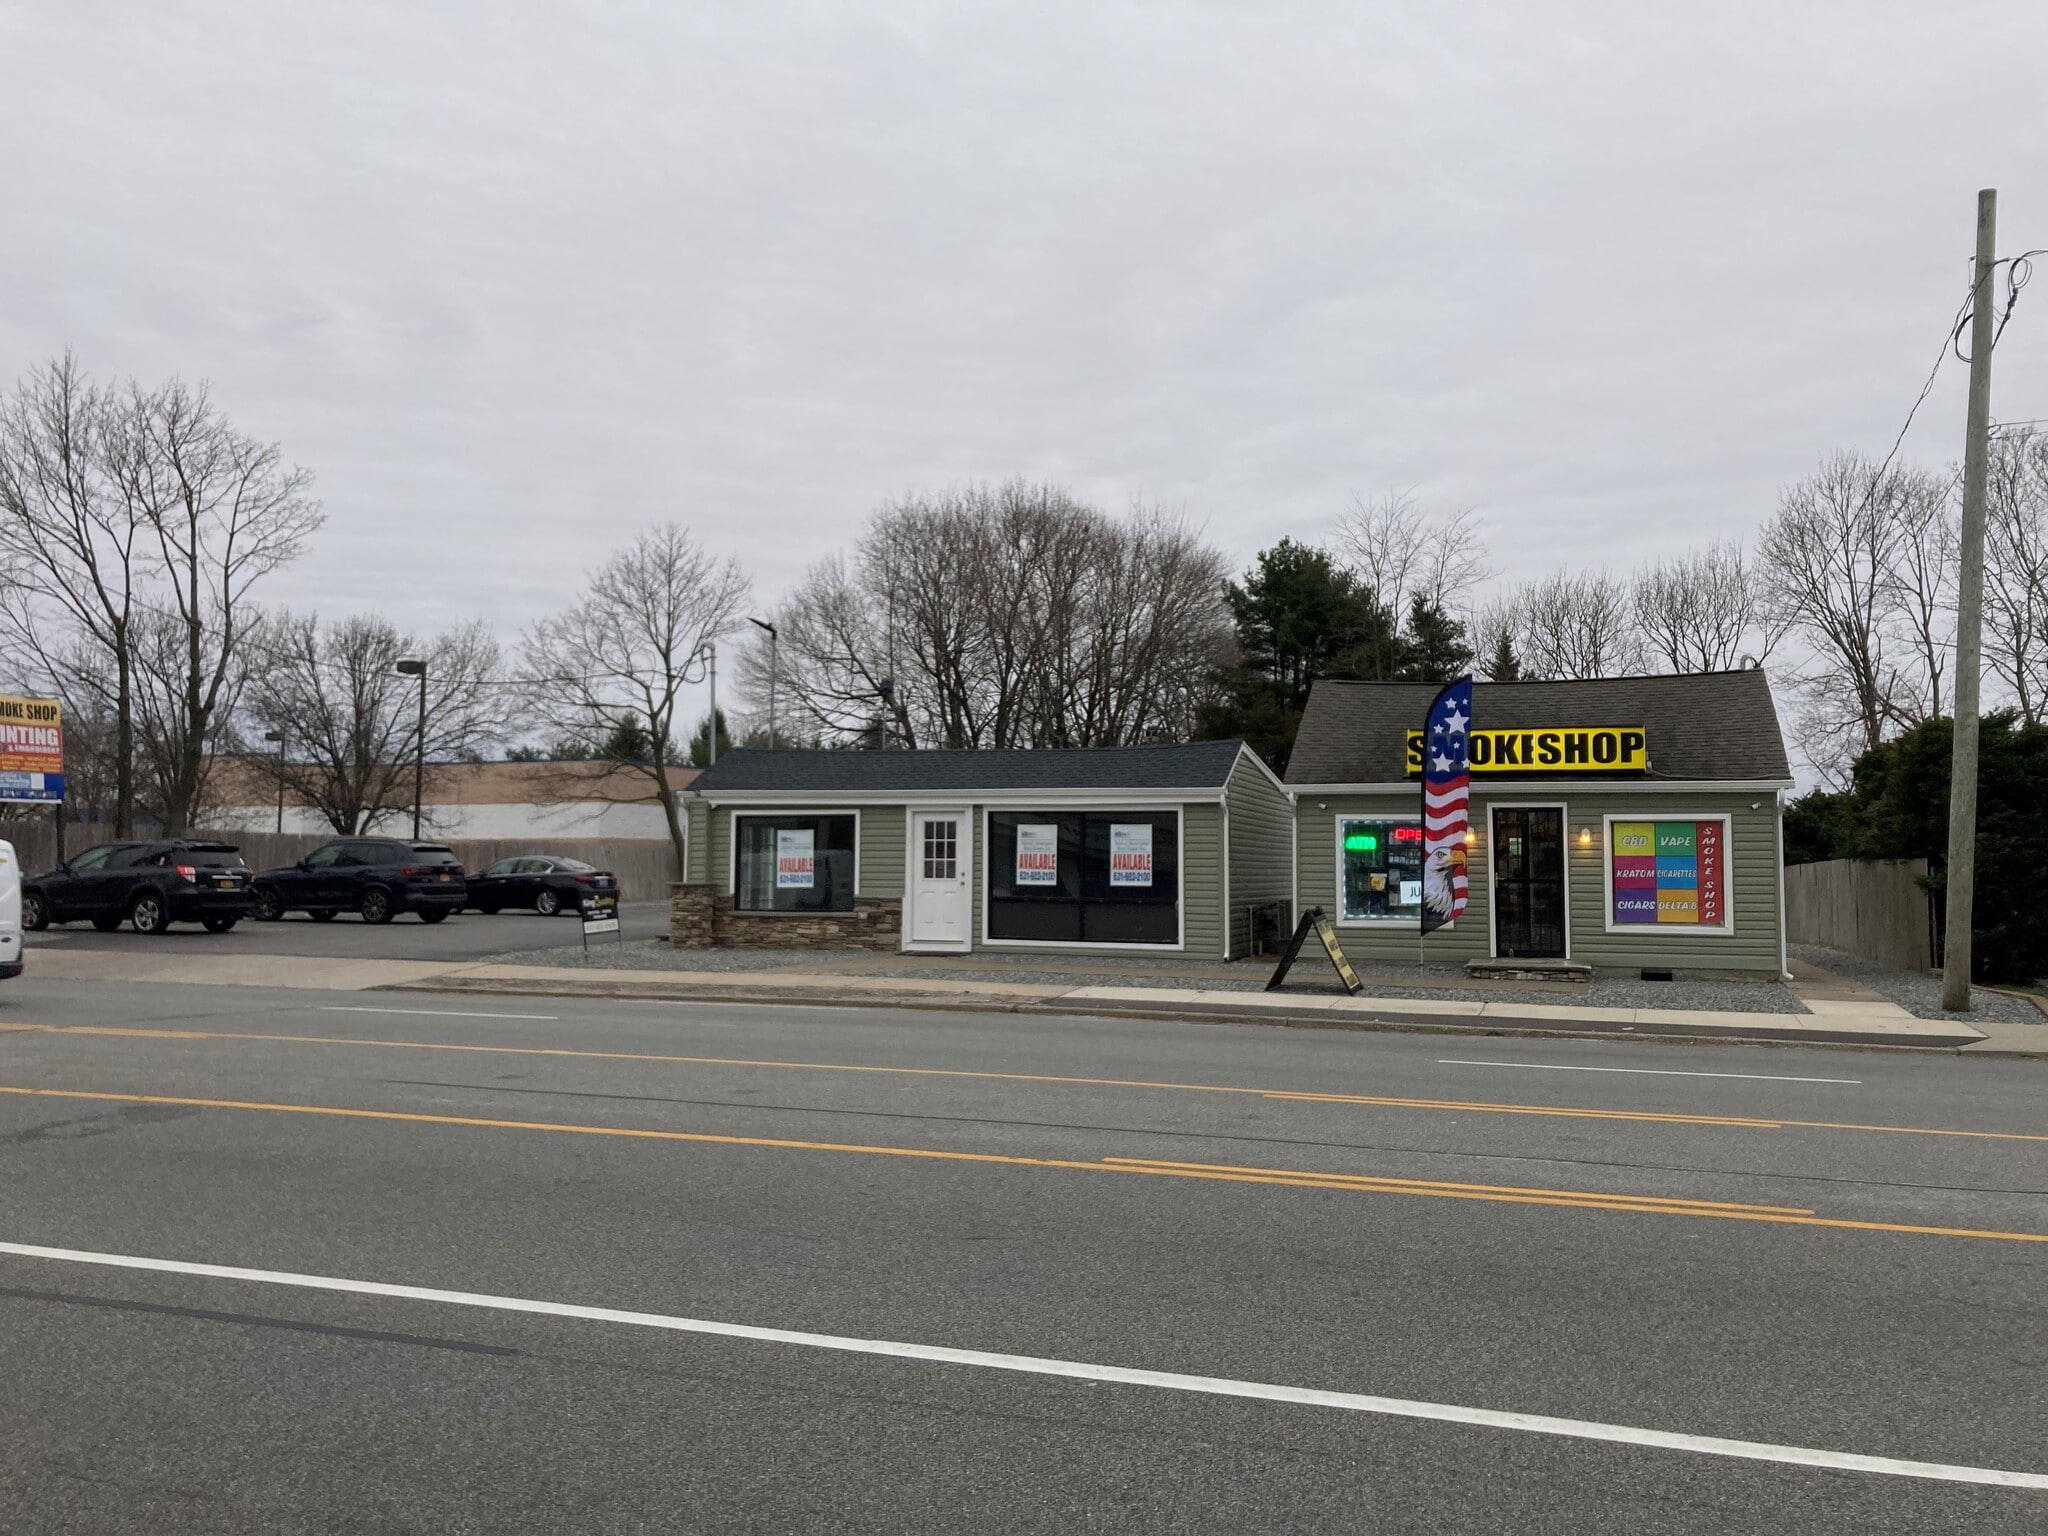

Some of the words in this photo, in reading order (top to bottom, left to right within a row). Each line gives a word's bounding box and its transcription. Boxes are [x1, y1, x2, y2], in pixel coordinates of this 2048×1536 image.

[26, 703, 57, 721] SHOP
[1395, 828, 1423, 840] OPE
[1622, 835, 1648, 846] CBD
[1347, 836, 1377, 850] ATM
[1660, 836, 1691, 846] VAPE
[1701, 826, 1716, 875] SMOKE
[779, 857, 813, 873] AVAILABLE
[1019, 853, 1056, 870] AVAILABLE
[1113, 853, 1151, 870] AVAILABLE
[1616, 869, 1655, 878] KRATOM
[1657, 869, 1697, 878] CIGARETTES
[1617, 900, 1656, 910] CIGARS
[1658, 900, 1689, 910] DELTA
[1704, 881, 1716, 919] SHOP
